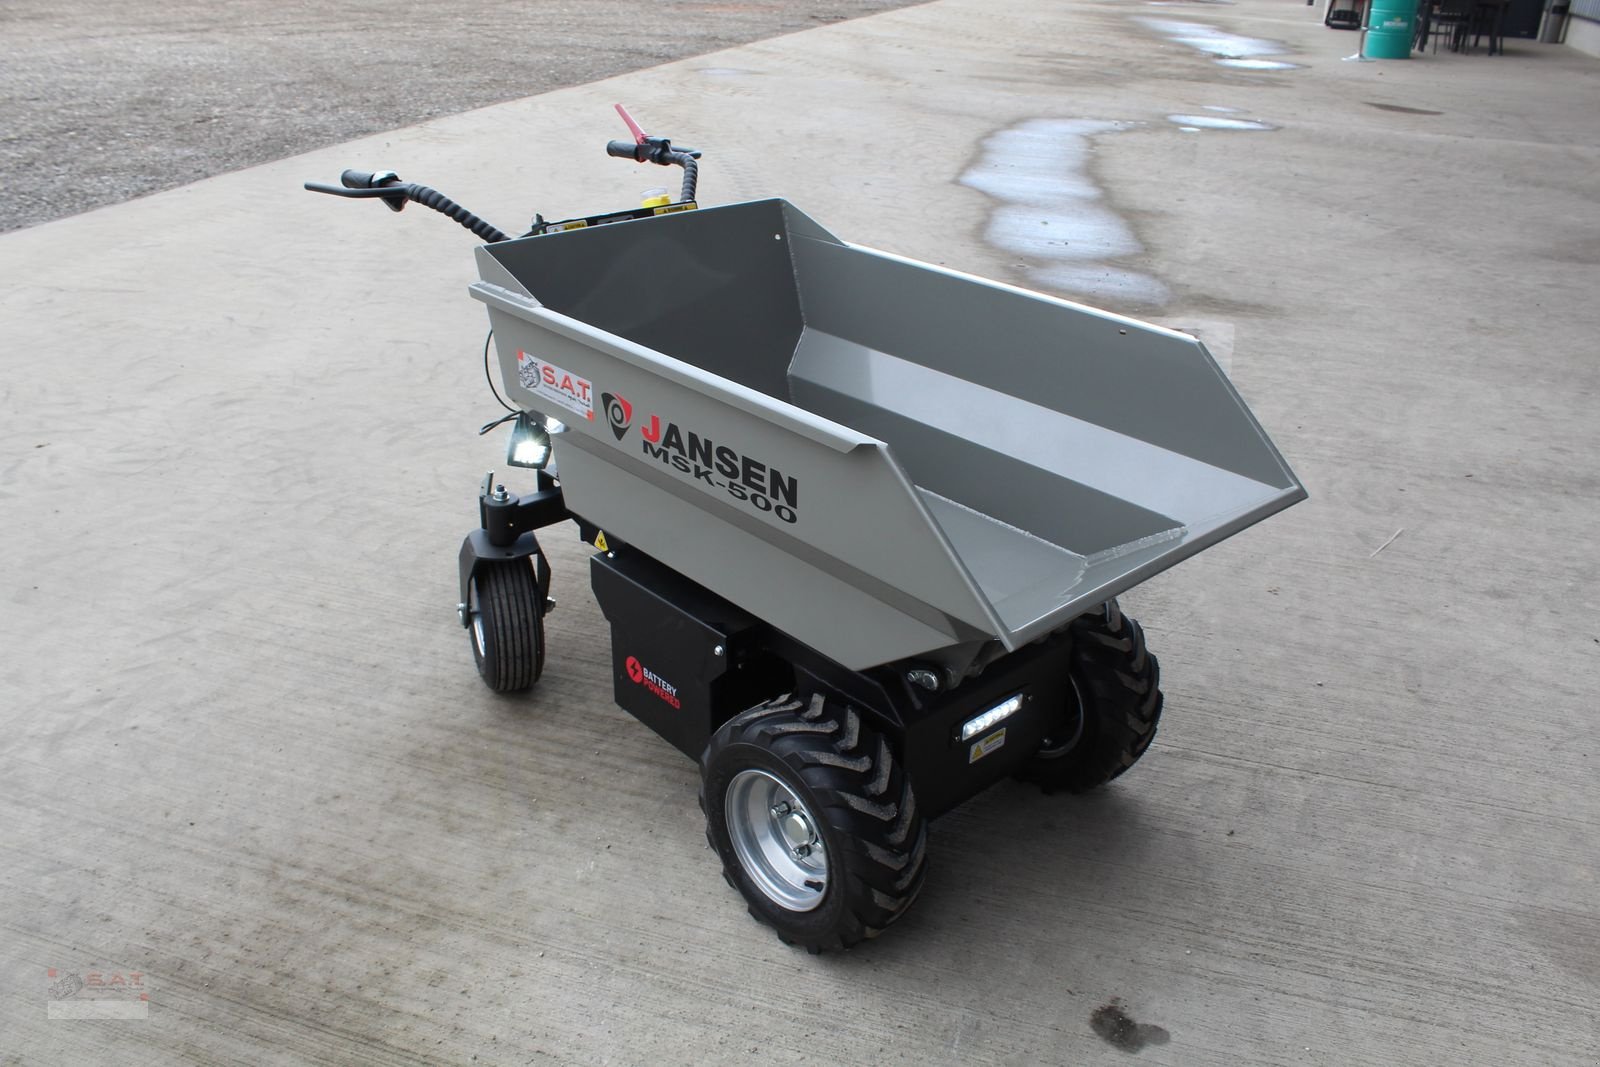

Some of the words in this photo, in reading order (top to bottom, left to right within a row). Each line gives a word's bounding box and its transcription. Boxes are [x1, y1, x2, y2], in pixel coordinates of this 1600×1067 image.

[542, 365, 591, 403] S.A.T.
[641, 415, 798, 510] JANSEN
[642, 440, 798, 524] MSK-500
[643, 667, 677, 697] BATTERY
[643, 678, 681, 710] POWERED
